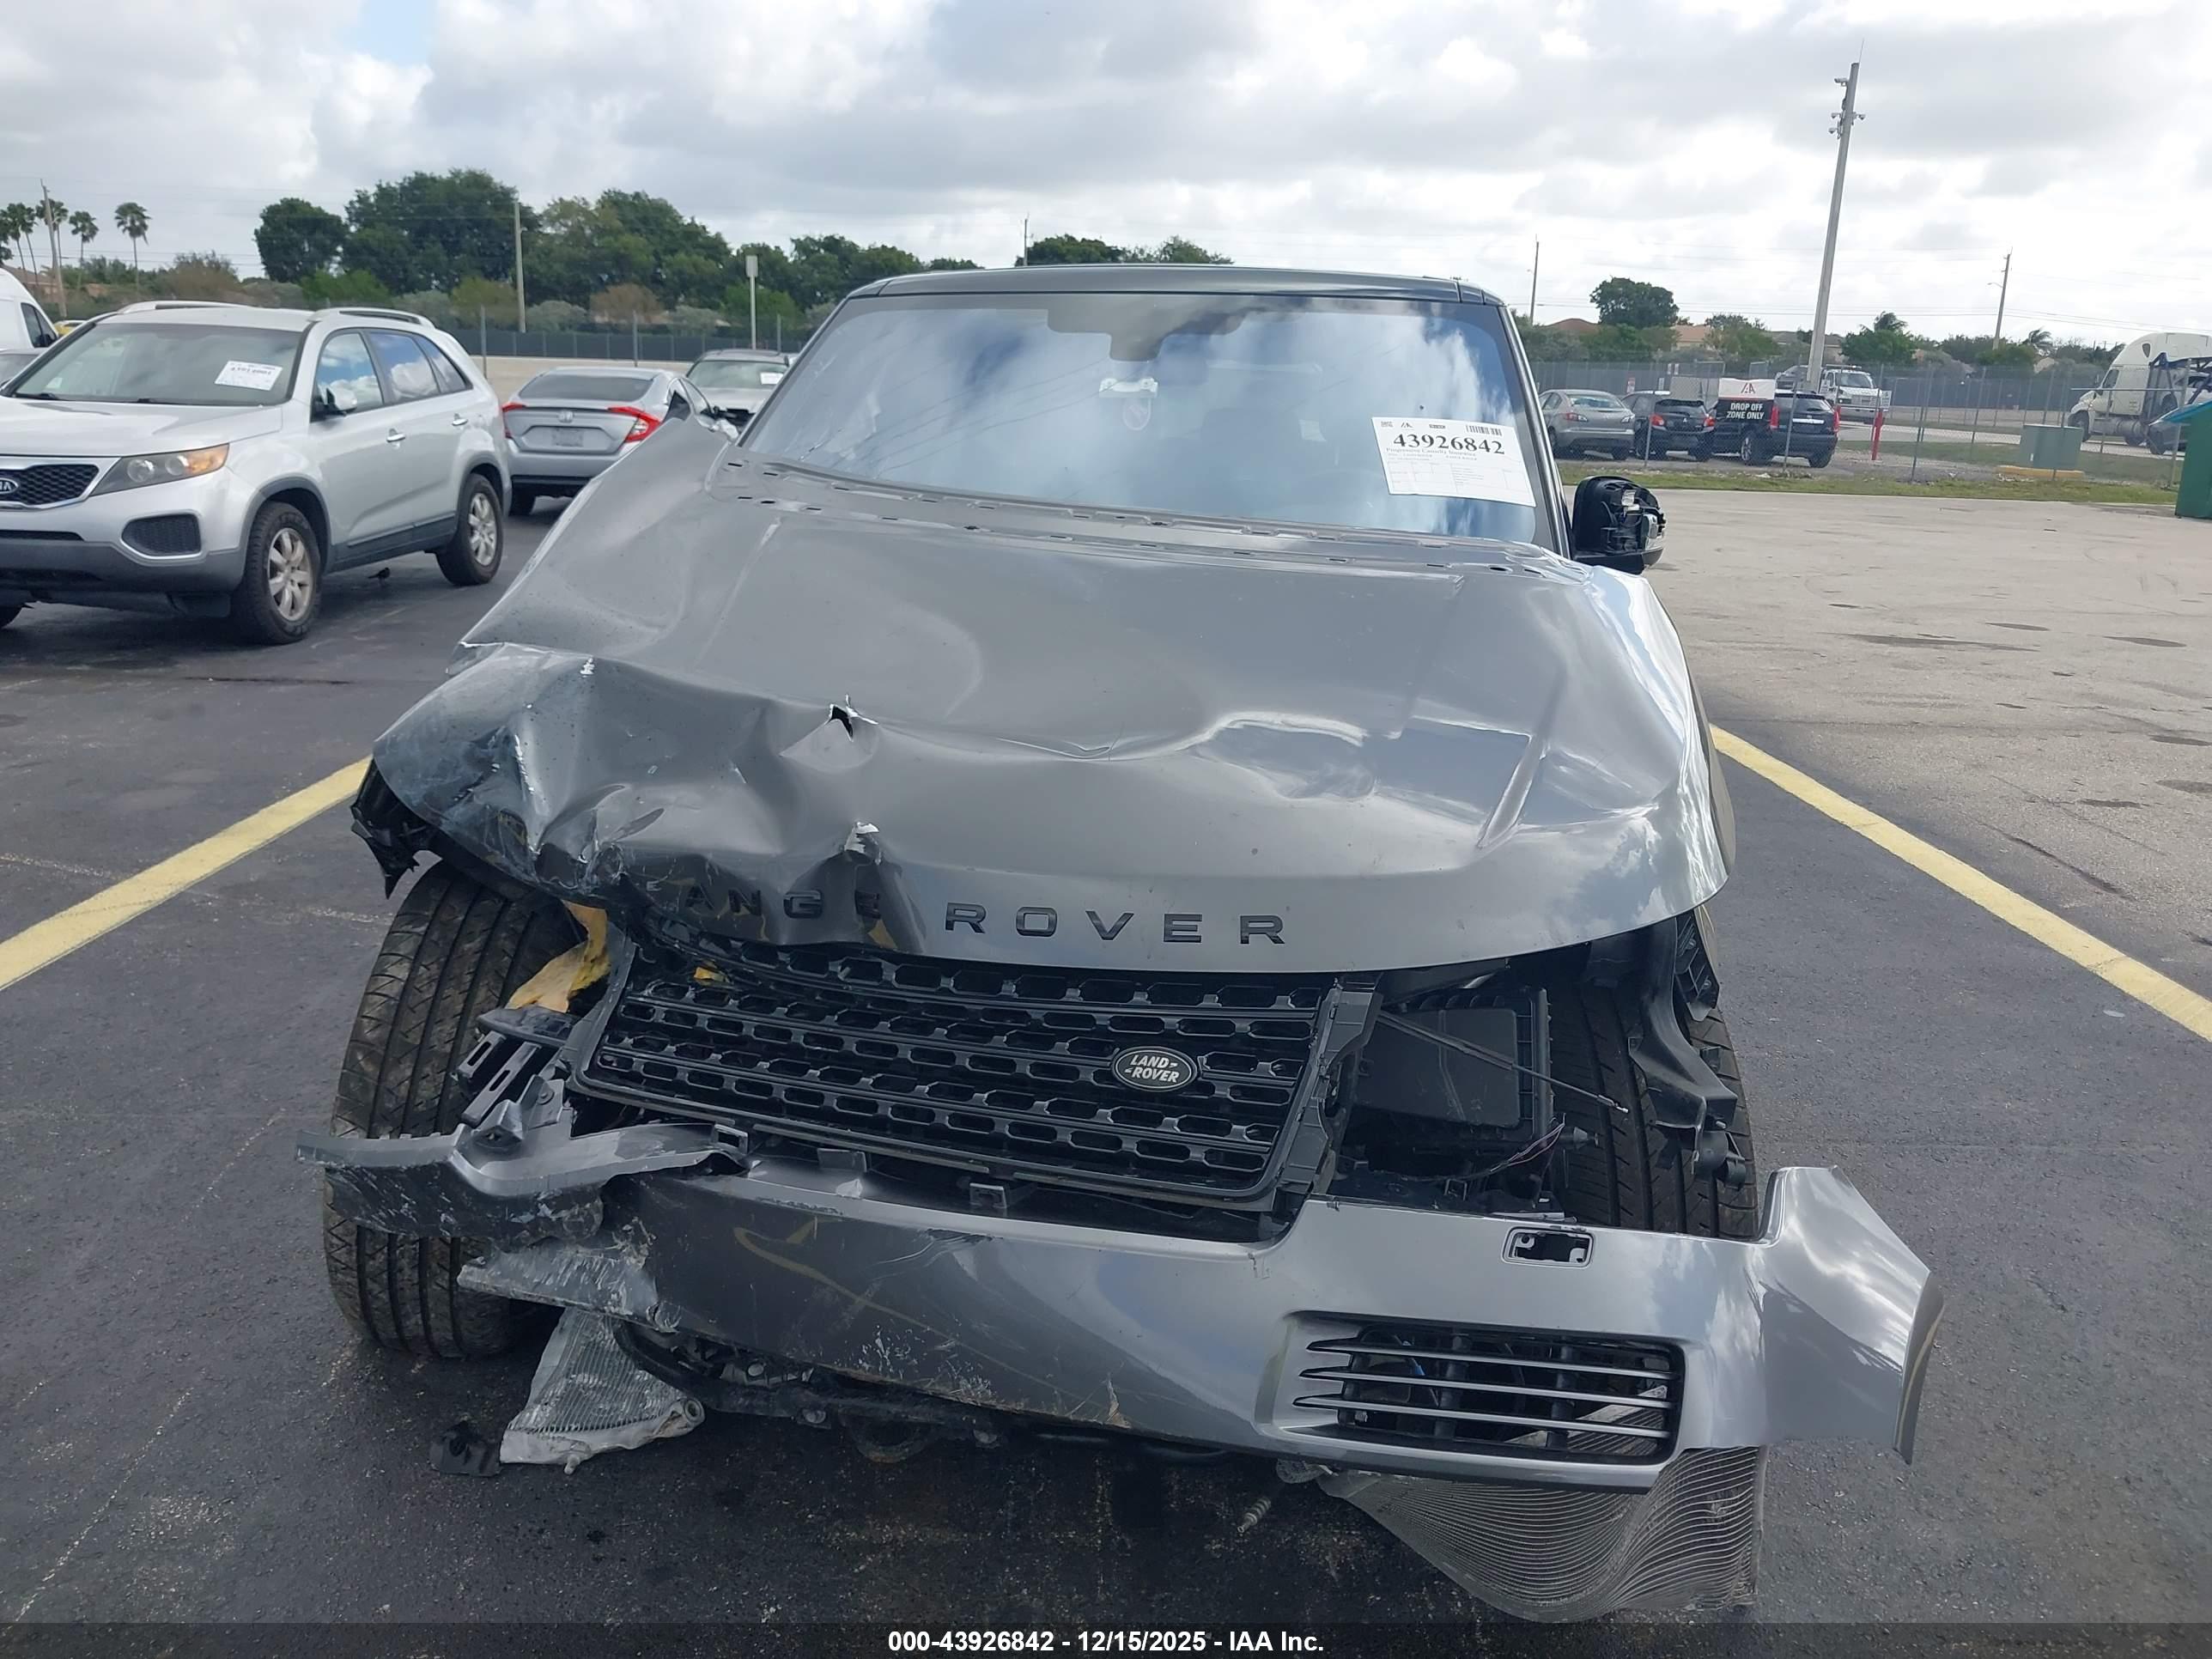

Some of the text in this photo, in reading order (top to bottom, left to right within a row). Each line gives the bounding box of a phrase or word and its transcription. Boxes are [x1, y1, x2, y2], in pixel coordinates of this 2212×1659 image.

[1726, 410, 1765, 420] ZONE ONLY
[1751, 403, 1764, 411] OFF
[1393, 433, 1505, 455] 43926842
[945, 902, 1285, 945] ROVER
